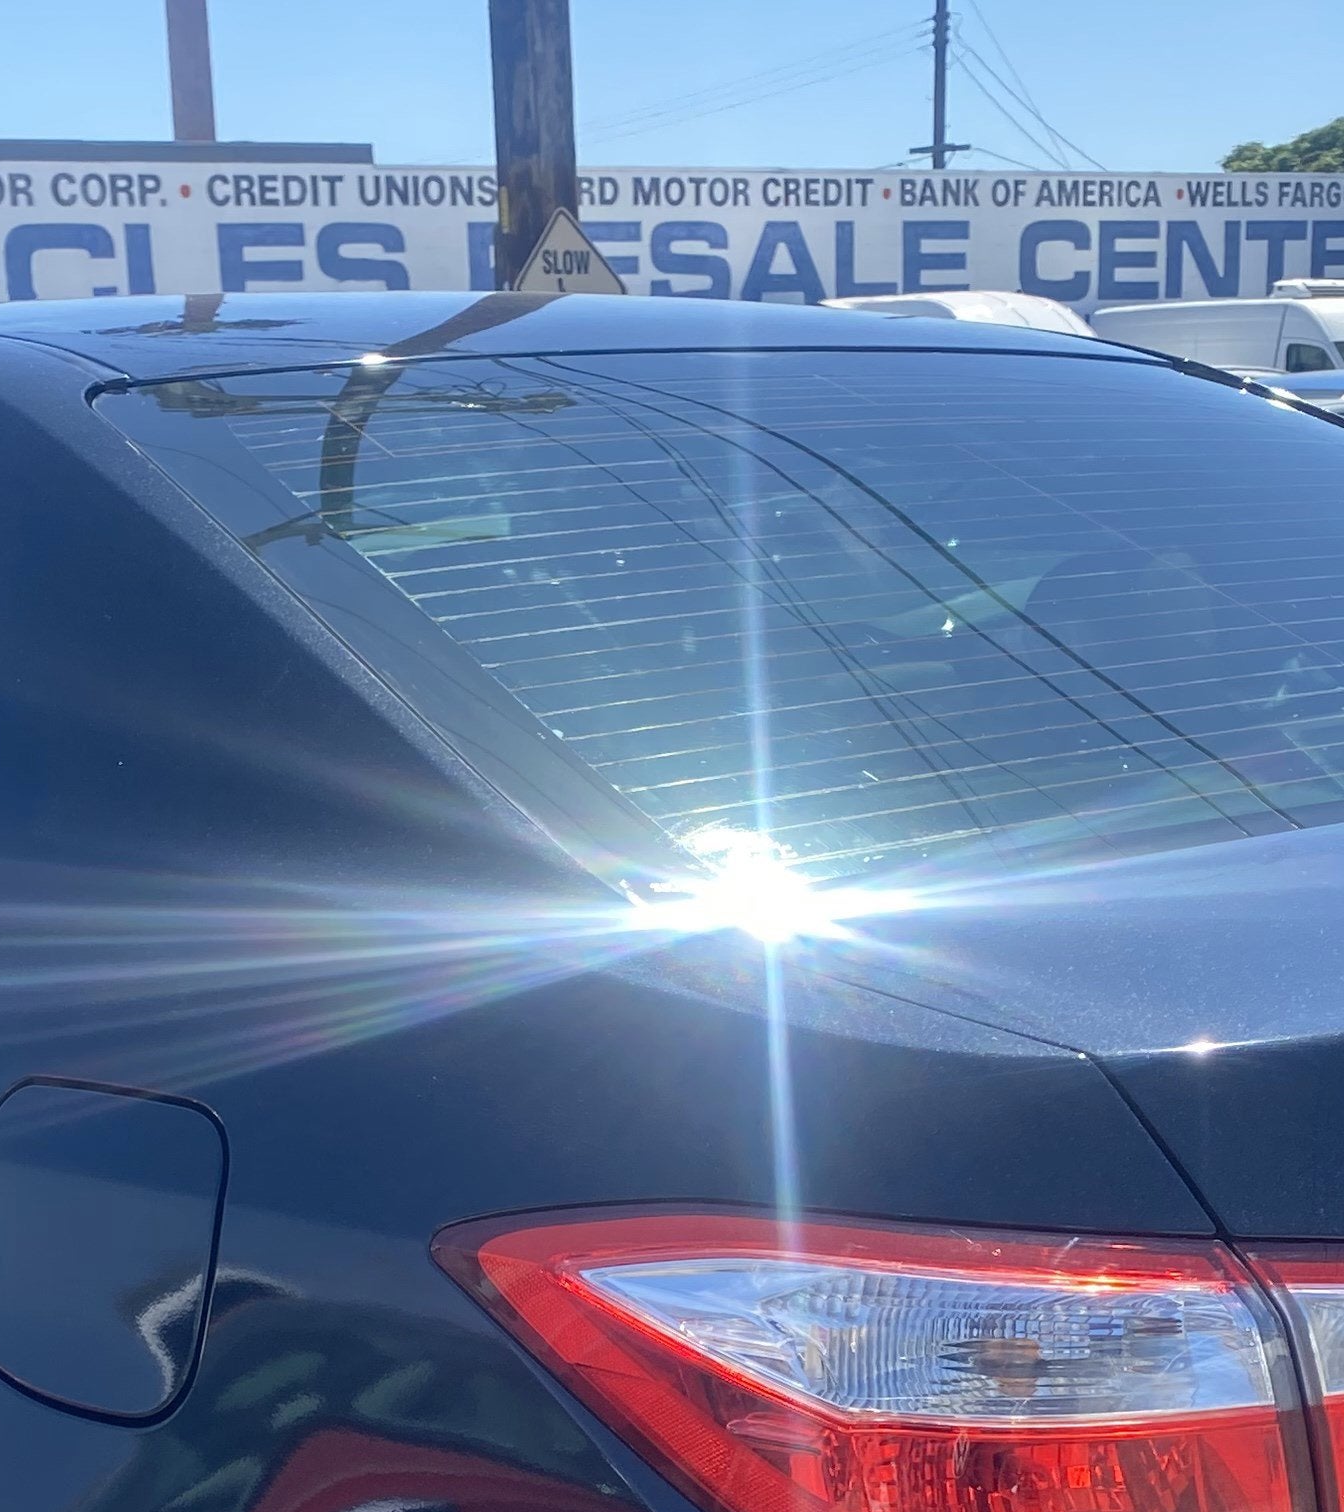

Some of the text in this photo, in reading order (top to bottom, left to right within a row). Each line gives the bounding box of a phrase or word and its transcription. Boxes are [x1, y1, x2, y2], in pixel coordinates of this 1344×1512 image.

[50, 172, 166, 207] CORP.
[207, 173, 344, 207] CREDIT
[358, 174, 498, 207] UNIONS
[578, 176, 620, 206] RD
[632, 176, 750, 207] MOTOR
[761, 177, 874, 207] CREDIT
[900, 178, 980, 208] BANK
[991, 179, 1026, 208] OF
[1035, 178, 1163, 209] AMERICA
[1188, 181, 1267, 209] WELLS
[467, 221, 970, 307] SALE
[542, 250, 591, 275] SLOW
